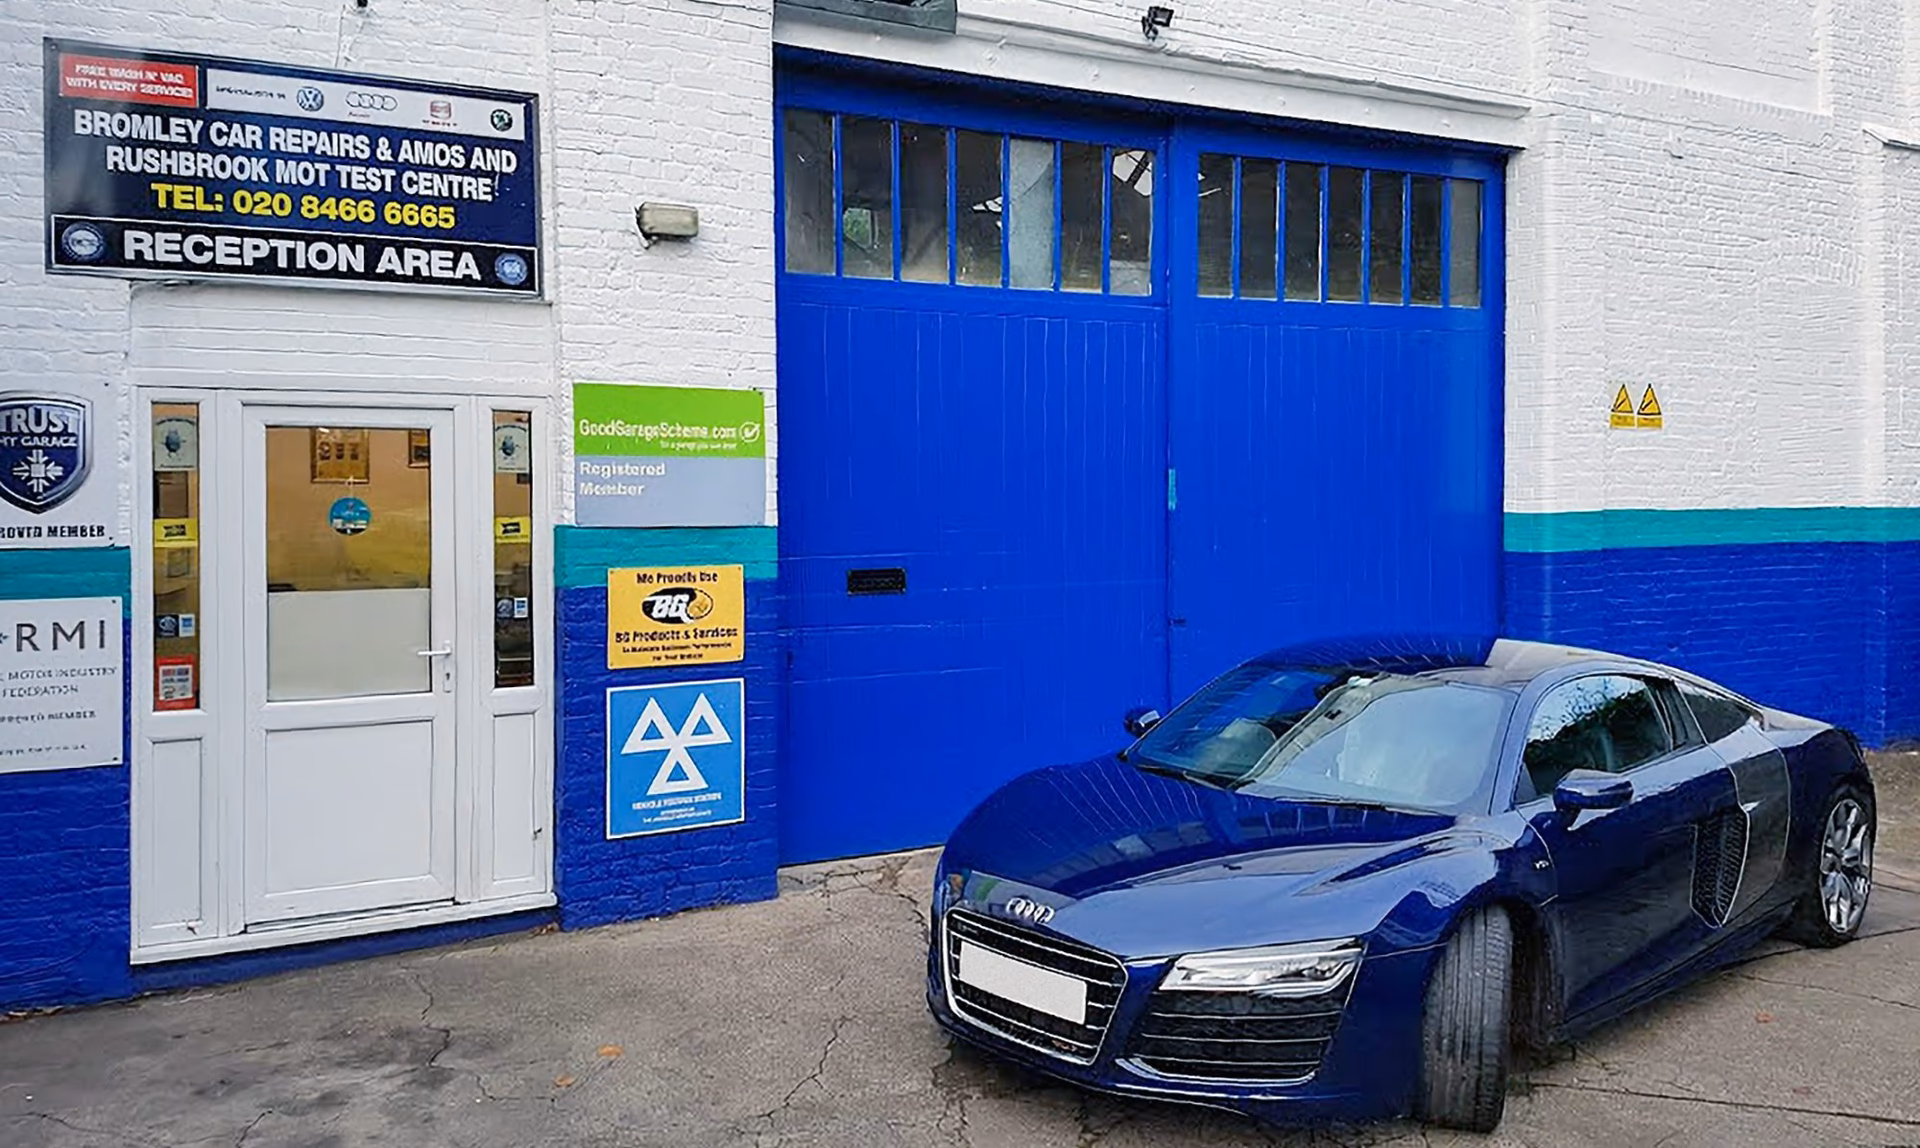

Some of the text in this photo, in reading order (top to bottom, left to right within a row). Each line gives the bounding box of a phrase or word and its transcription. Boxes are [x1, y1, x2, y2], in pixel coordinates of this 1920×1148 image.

[65, 76, 97, 88] WITH
[74, 109, 517, 173] BROMLEY CAR REPAIRS & AMOS AND
[106, 145, 493, 201] RUSHBROOK MOT TEST CENTRE
[150, 182, 456, 229] TEL: 020 8466 6665
[123, 229, 365, 273] RECEPTION
[375, 246, 481, 281] AREA
[579, 461, 666, 479] Registered
[579, 482, 645, 496] Member
[47, 524, 105, 538] MEMBER
[16, 620, 105, 652] RMI
